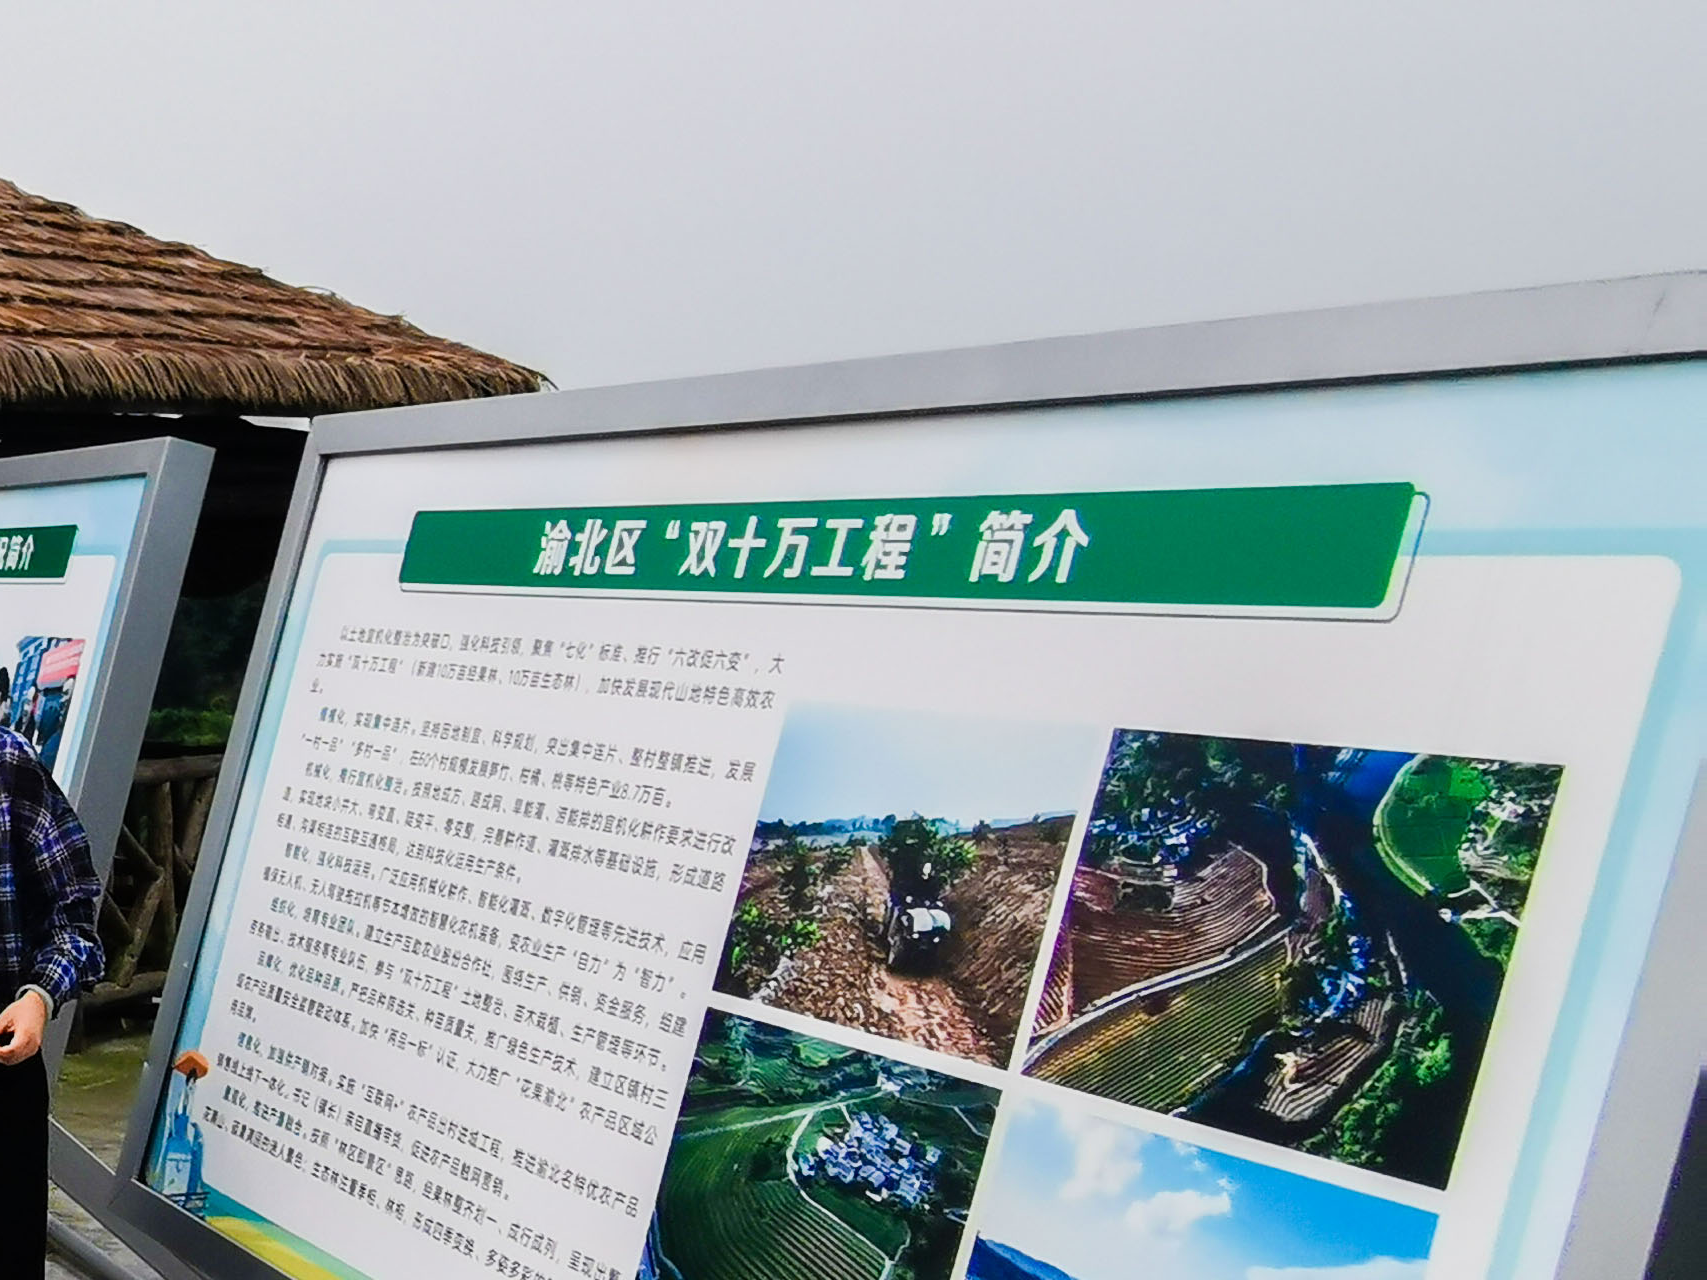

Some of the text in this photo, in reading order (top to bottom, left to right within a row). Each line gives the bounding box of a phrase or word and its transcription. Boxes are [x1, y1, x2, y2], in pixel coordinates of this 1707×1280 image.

[532, 508, 1090, 584] 渝北区“双十万工程”简介
